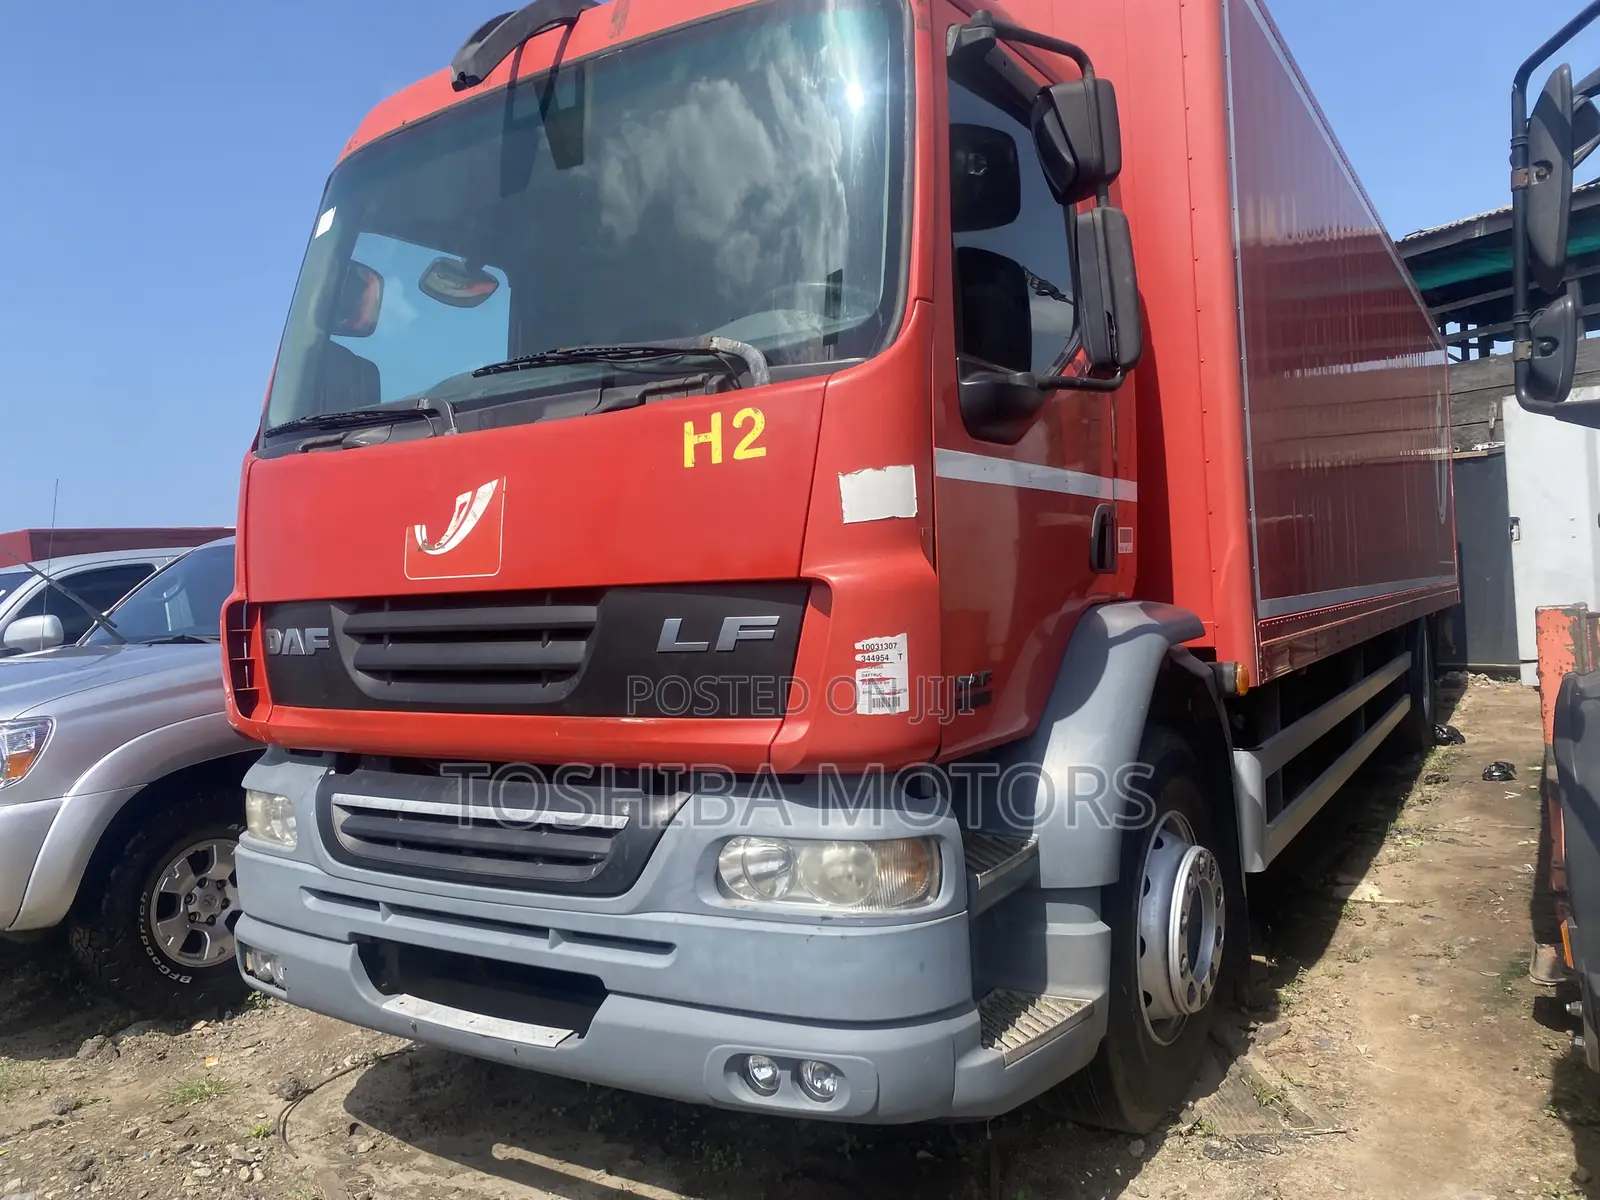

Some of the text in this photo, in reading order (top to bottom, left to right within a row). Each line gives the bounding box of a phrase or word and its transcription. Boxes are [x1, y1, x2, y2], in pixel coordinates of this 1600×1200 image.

[684, 407, 767, 468] H2
[265, 627, 330, 655] DAF
[656, 615, 780, 652] LF
[861, 642, 898, 651] 10031307
[860, 652, 903, 662] 344954 T
